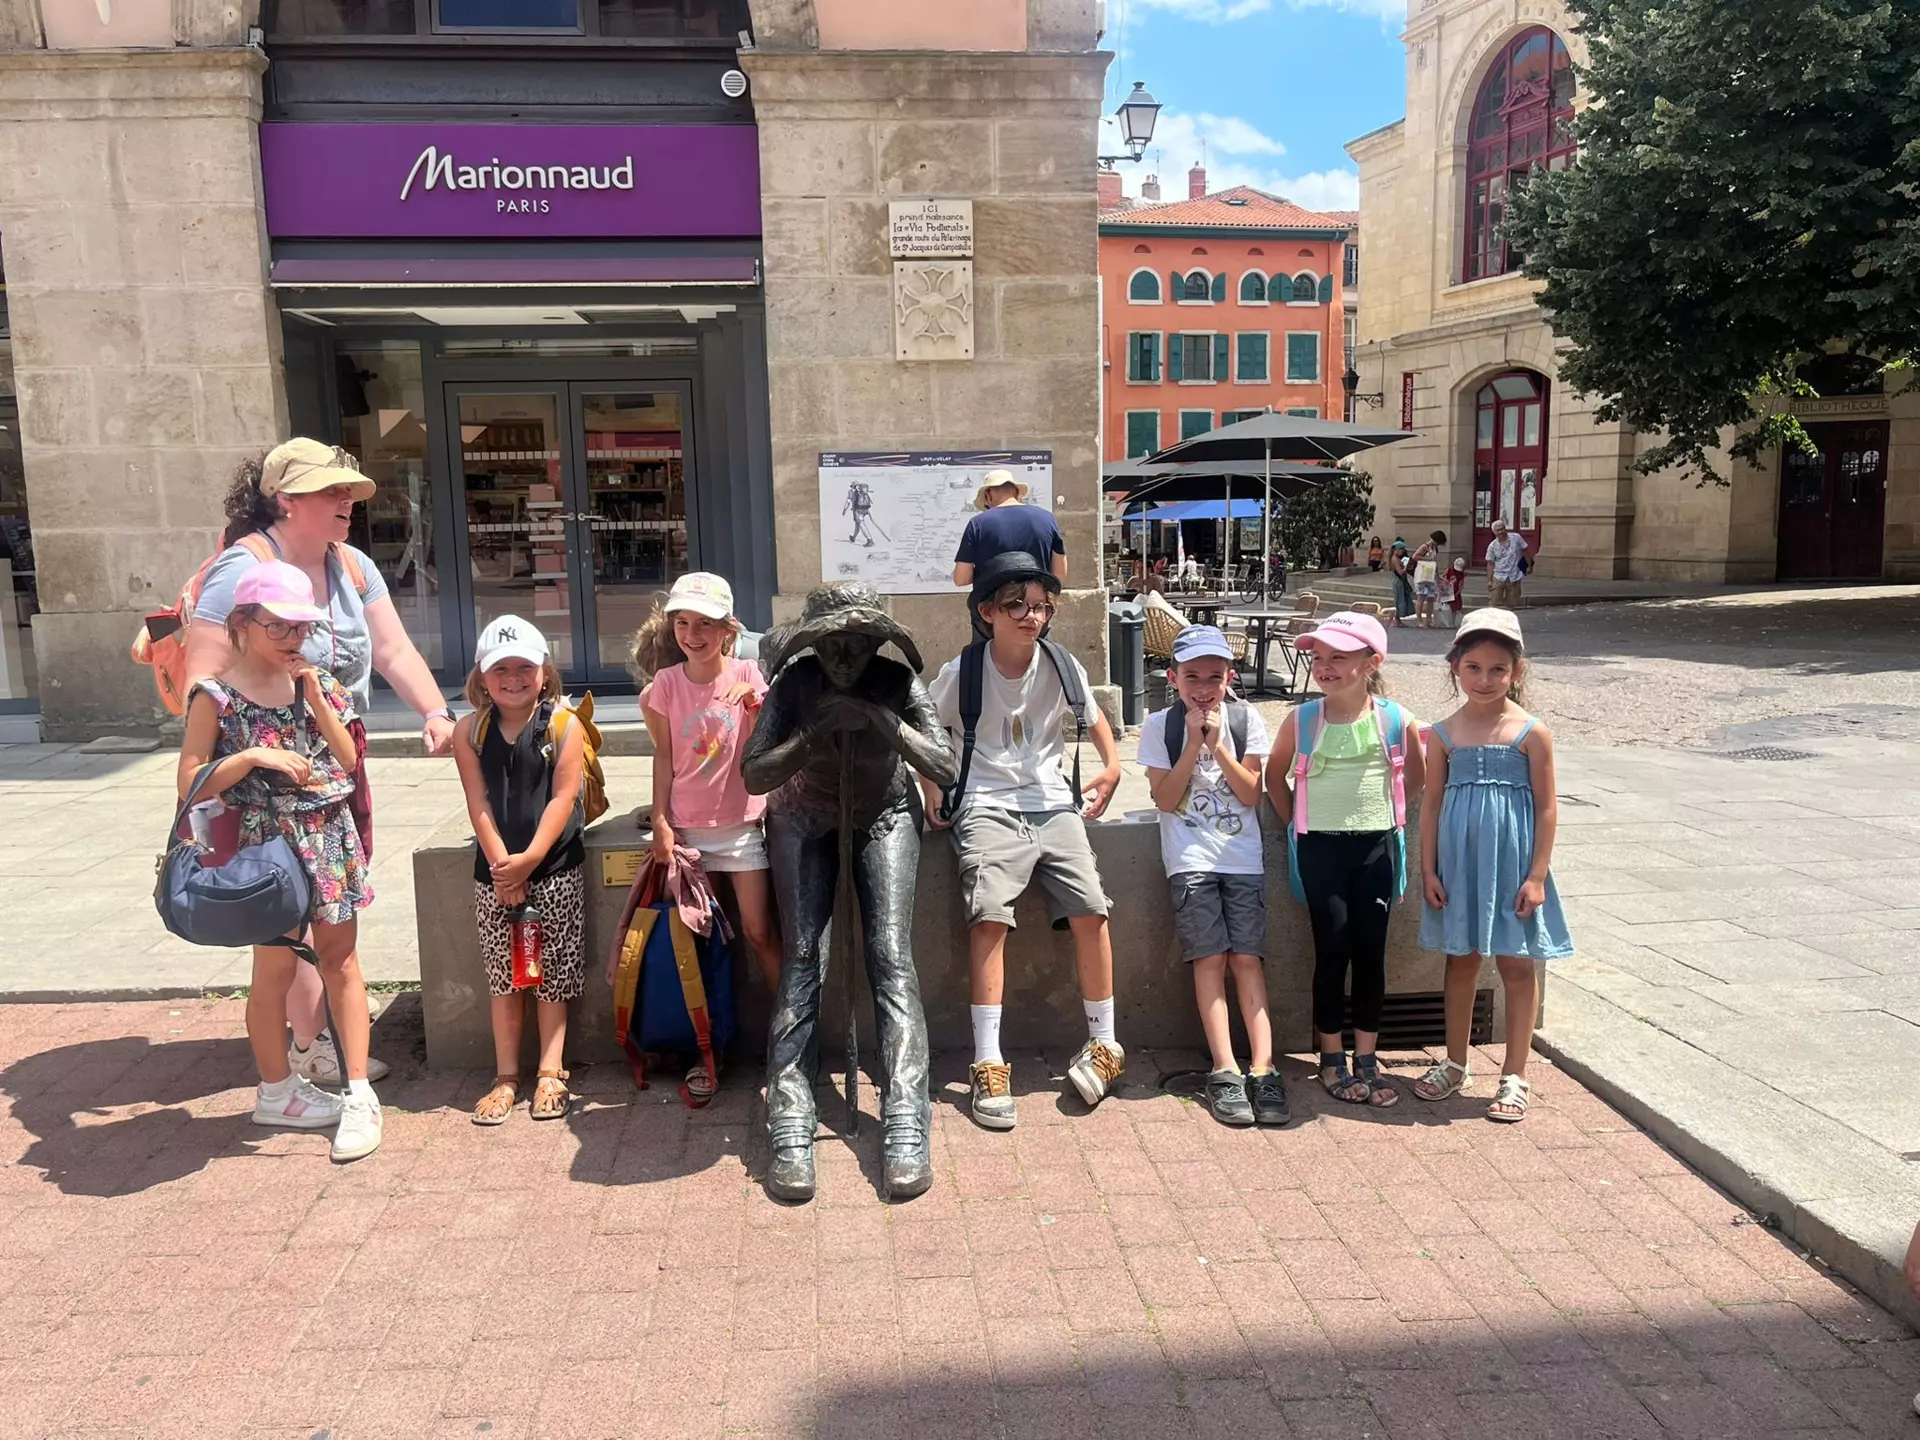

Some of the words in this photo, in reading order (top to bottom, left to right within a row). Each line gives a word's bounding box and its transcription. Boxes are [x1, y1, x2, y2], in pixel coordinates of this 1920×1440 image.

[400, 145, 634, 201] Marionnaud
[497, 199, 550, 213] PARIS
[922, 205, 938, 213] ICI
[893, 222, 903, 232] la
[892, 234, 913, 243] grande
[909, 244, 933, 253] Jacques
[940, 244, 972, 252] Compostelle
[498, 626, 518, 643] NY
